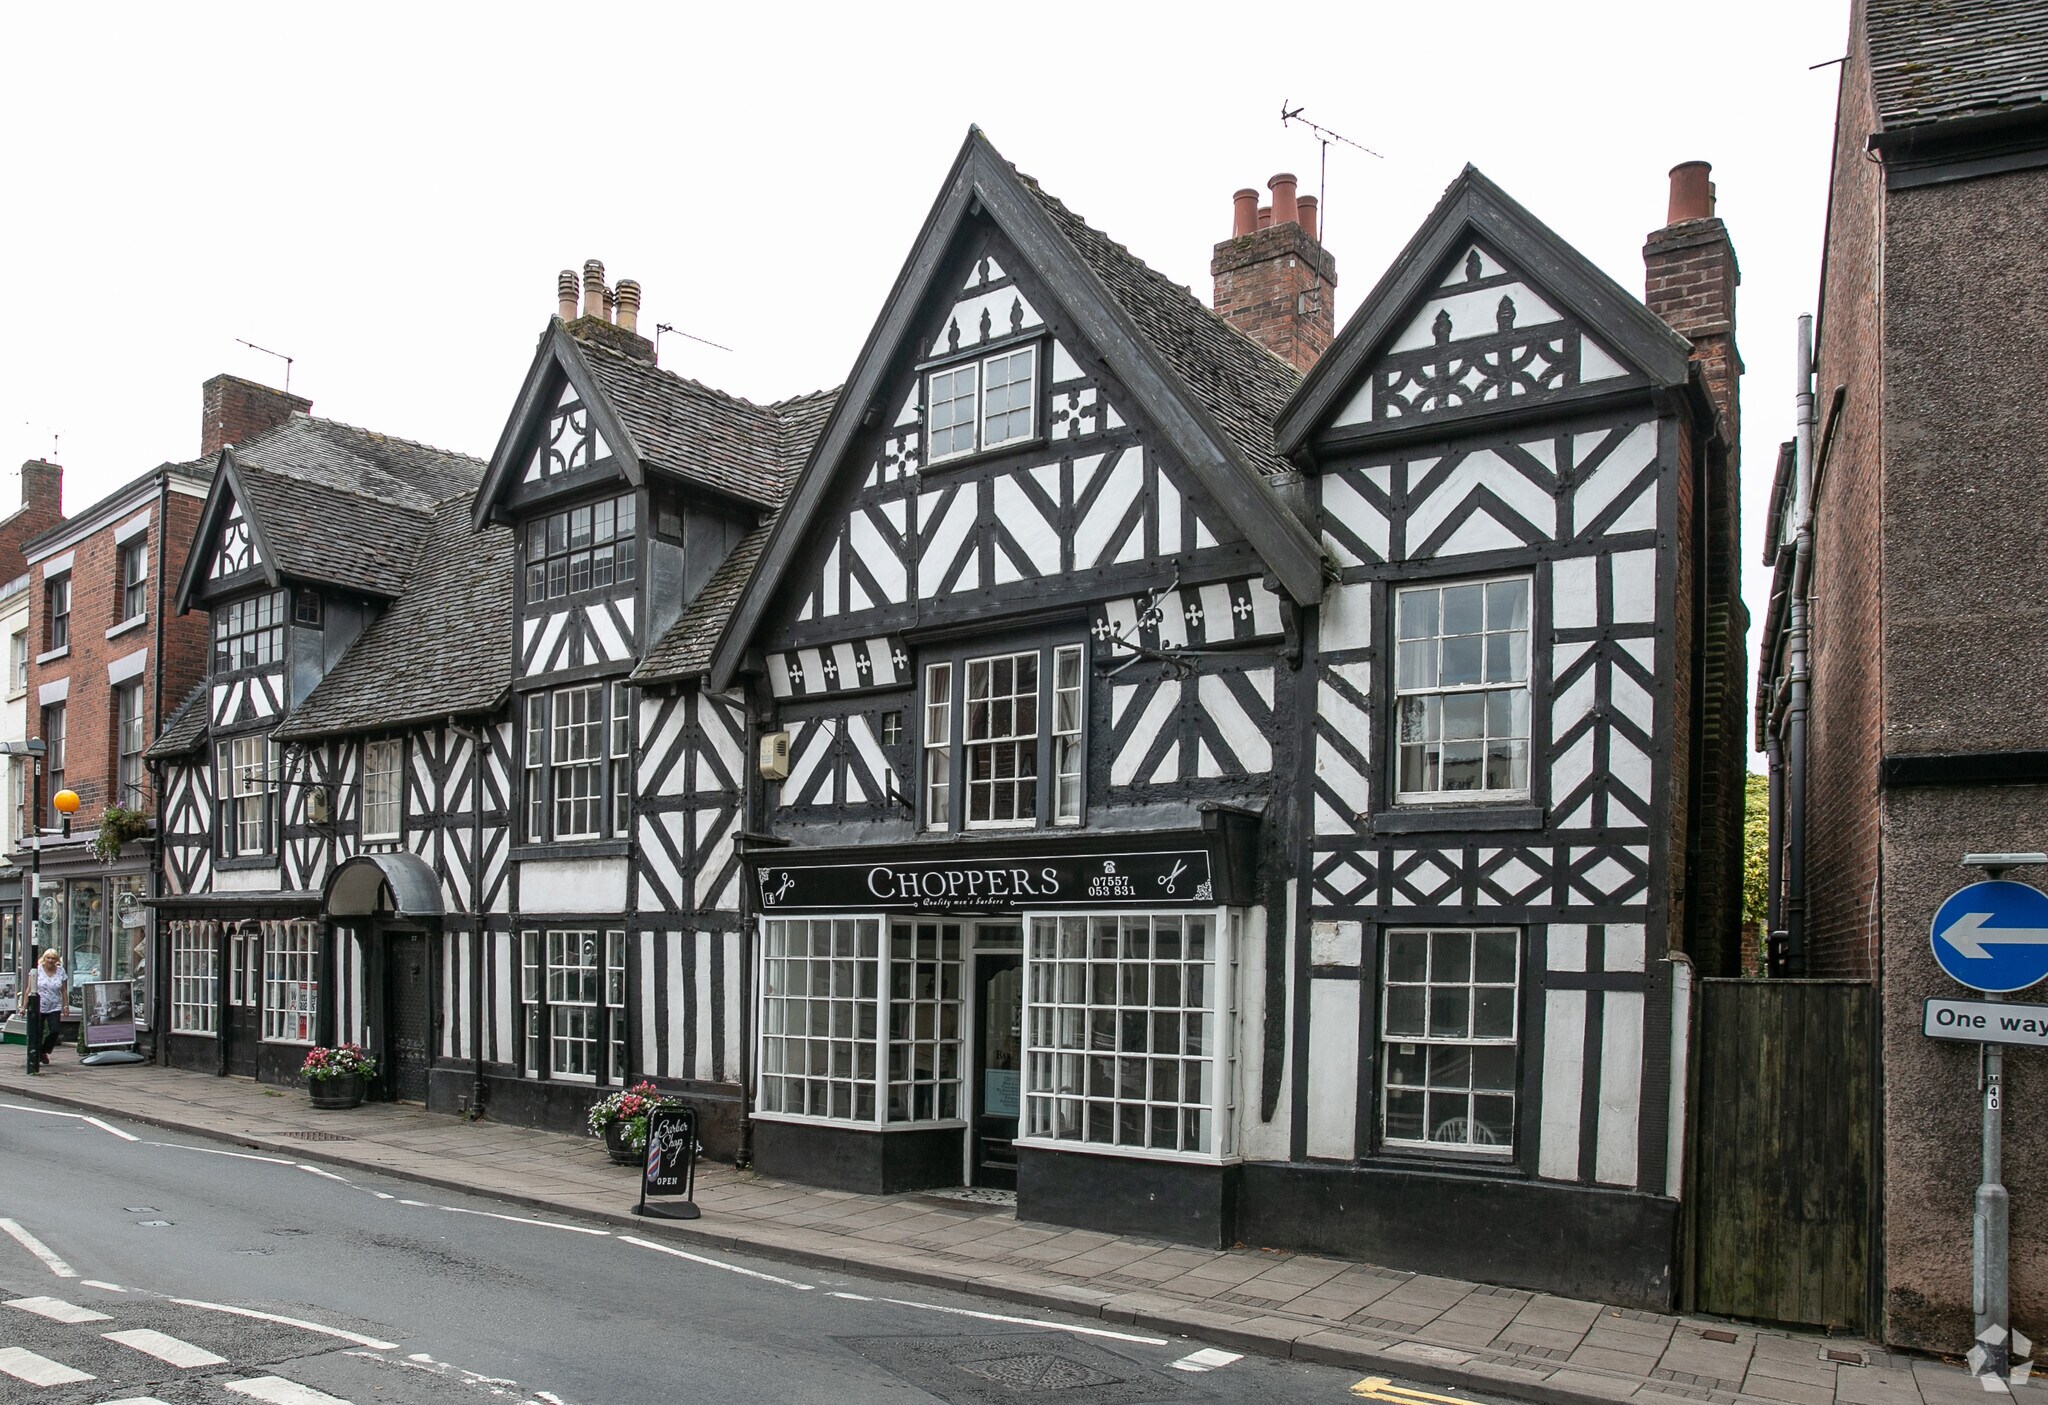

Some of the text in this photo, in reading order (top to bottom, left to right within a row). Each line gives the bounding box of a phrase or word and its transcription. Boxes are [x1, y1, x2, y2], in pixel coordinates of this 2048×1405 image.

[867, 867, 1060, 899] CHOPPERS
[1092, 876, 1129, 887] 07557
[1088, 885, 1136, 897] 053 831
[922, 897, 951, 909] Quality
[975, 896, 1004, 905] barbers
[1936, 1008, 2048, 1037] One way
[658, 1119, 688, 1139] Barber
[660, 1133, 683, 1152] Shop
[656, 1177, 678, 1186] OPEN
